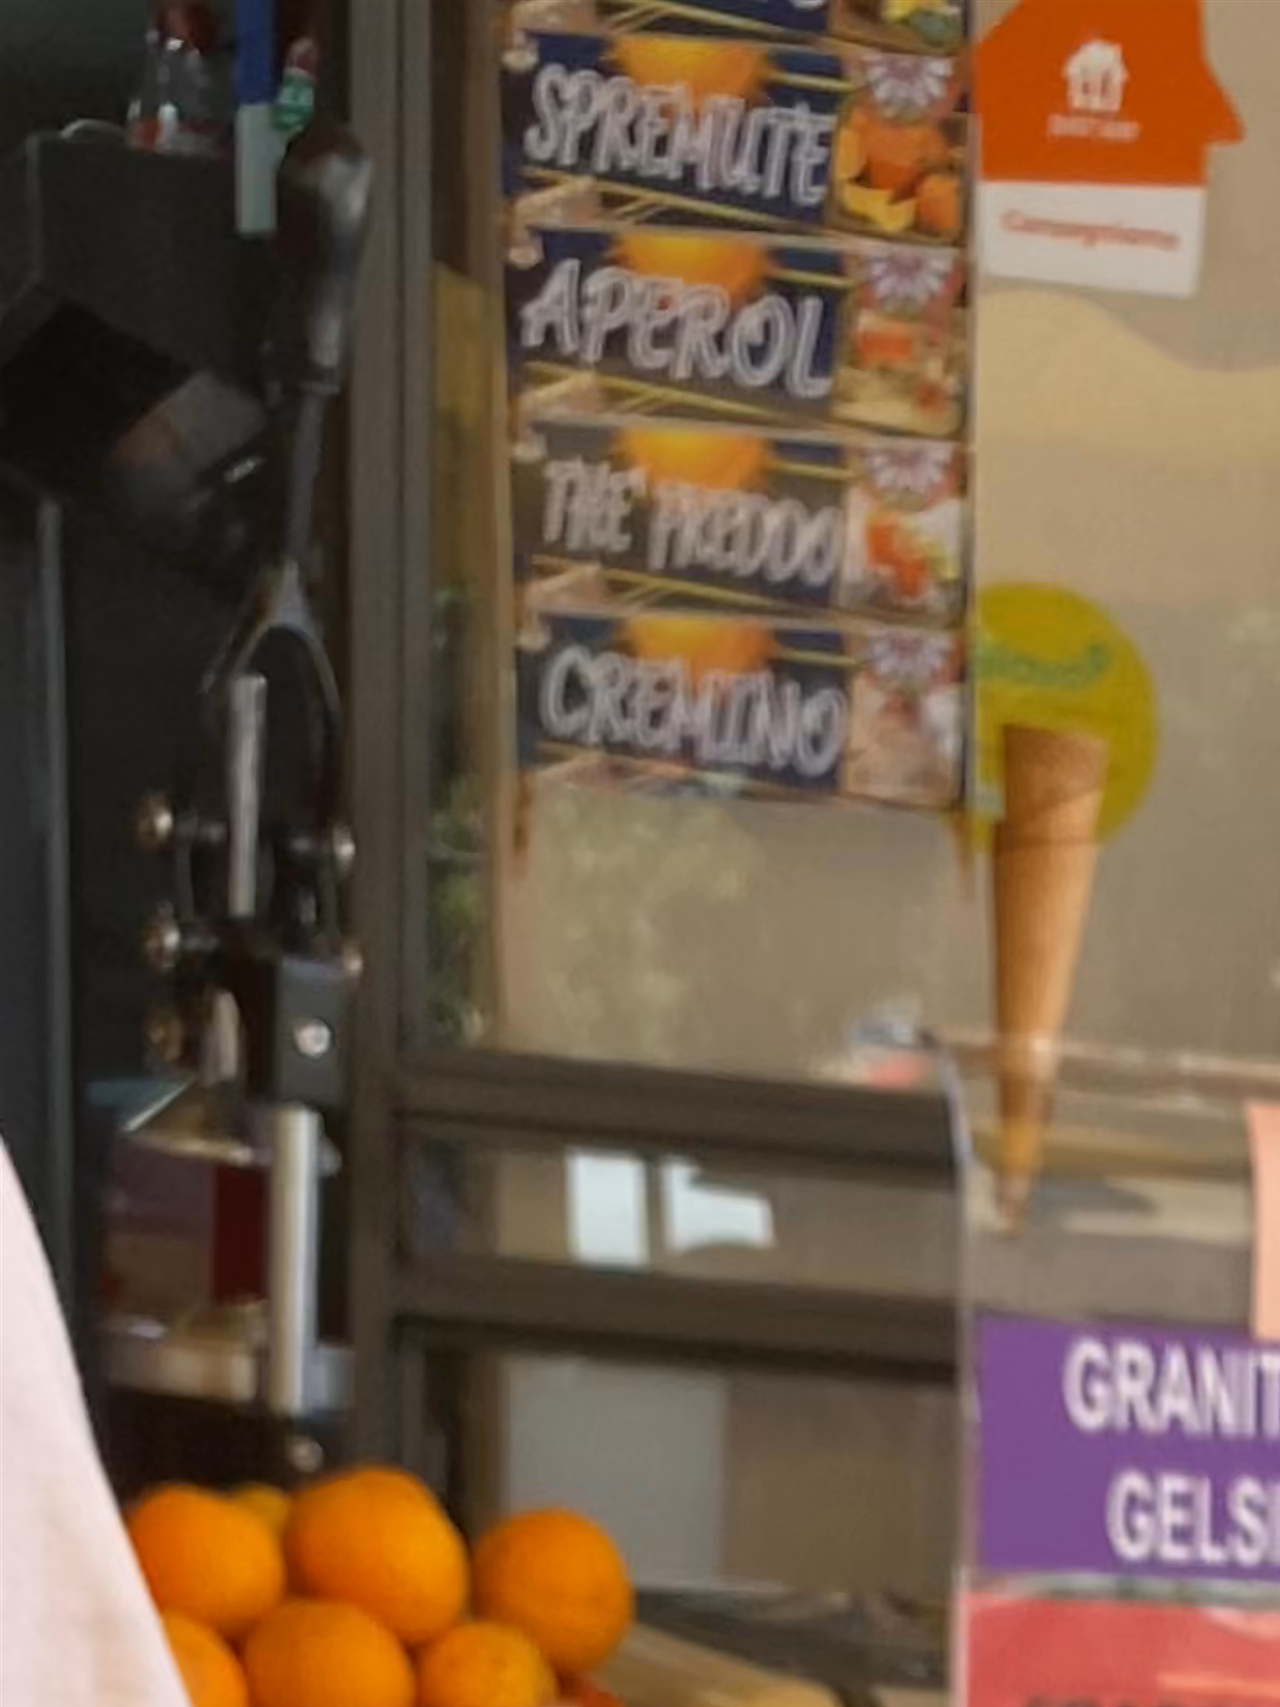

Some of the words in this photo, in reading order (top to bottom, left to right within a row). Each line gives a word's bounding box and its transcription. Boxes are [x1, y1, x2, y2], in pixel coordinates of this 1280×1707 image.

[523, 63, 837, 206] SPREMUTE
[520, 258, 833, 398] APEROL
[540, 645, 846, 777] CREMINO
